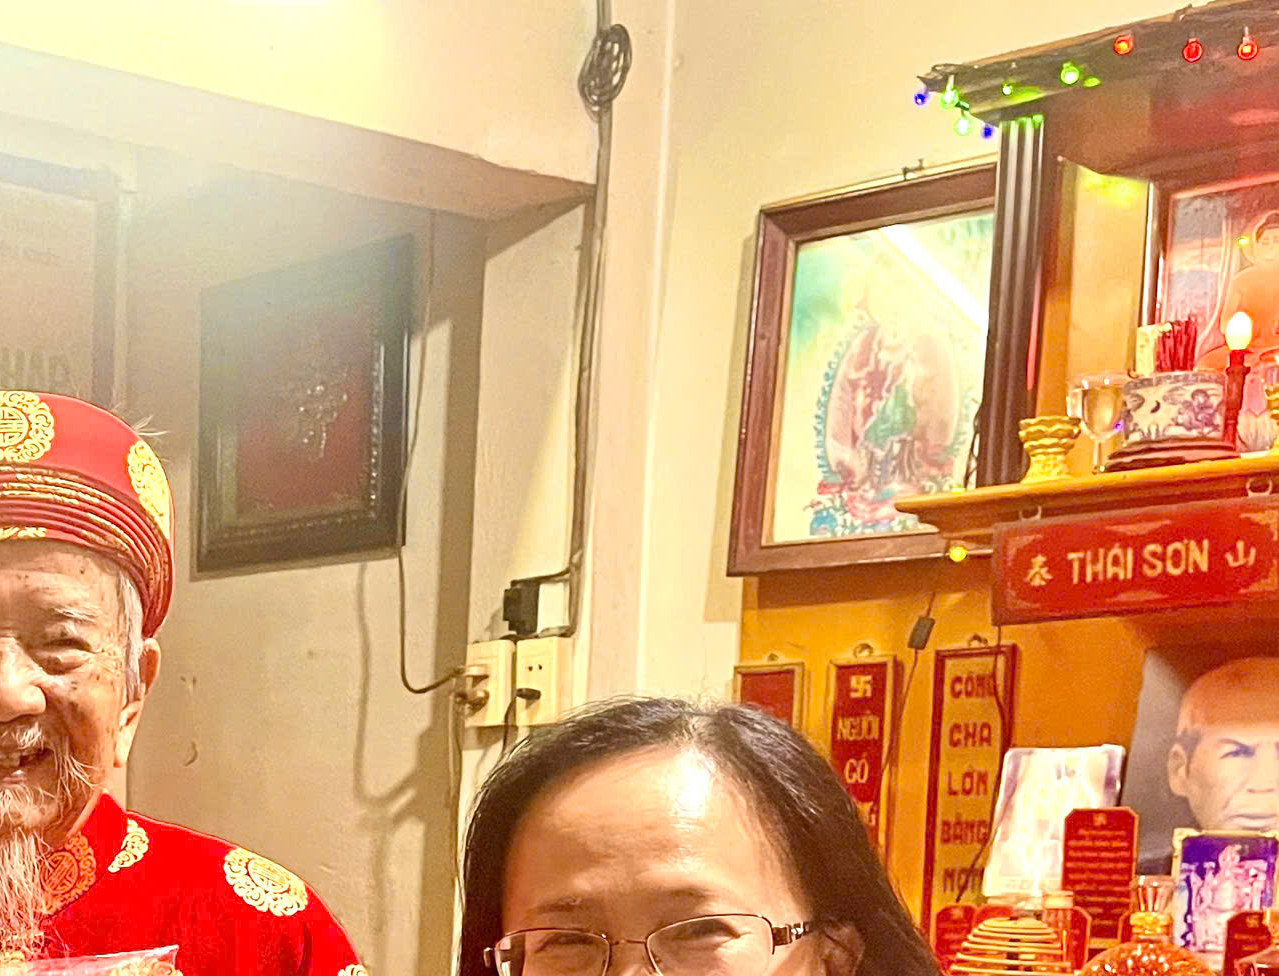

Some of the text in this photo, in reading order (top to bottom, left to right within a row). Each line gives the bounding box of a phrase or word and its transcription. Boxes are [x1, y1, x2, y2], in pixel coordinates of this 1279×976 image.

[1067, 539, 1209, 585] THÁI SƠN
[1224, 540, 1257, 568] 山
[948, 722, 992, 748] CHA
